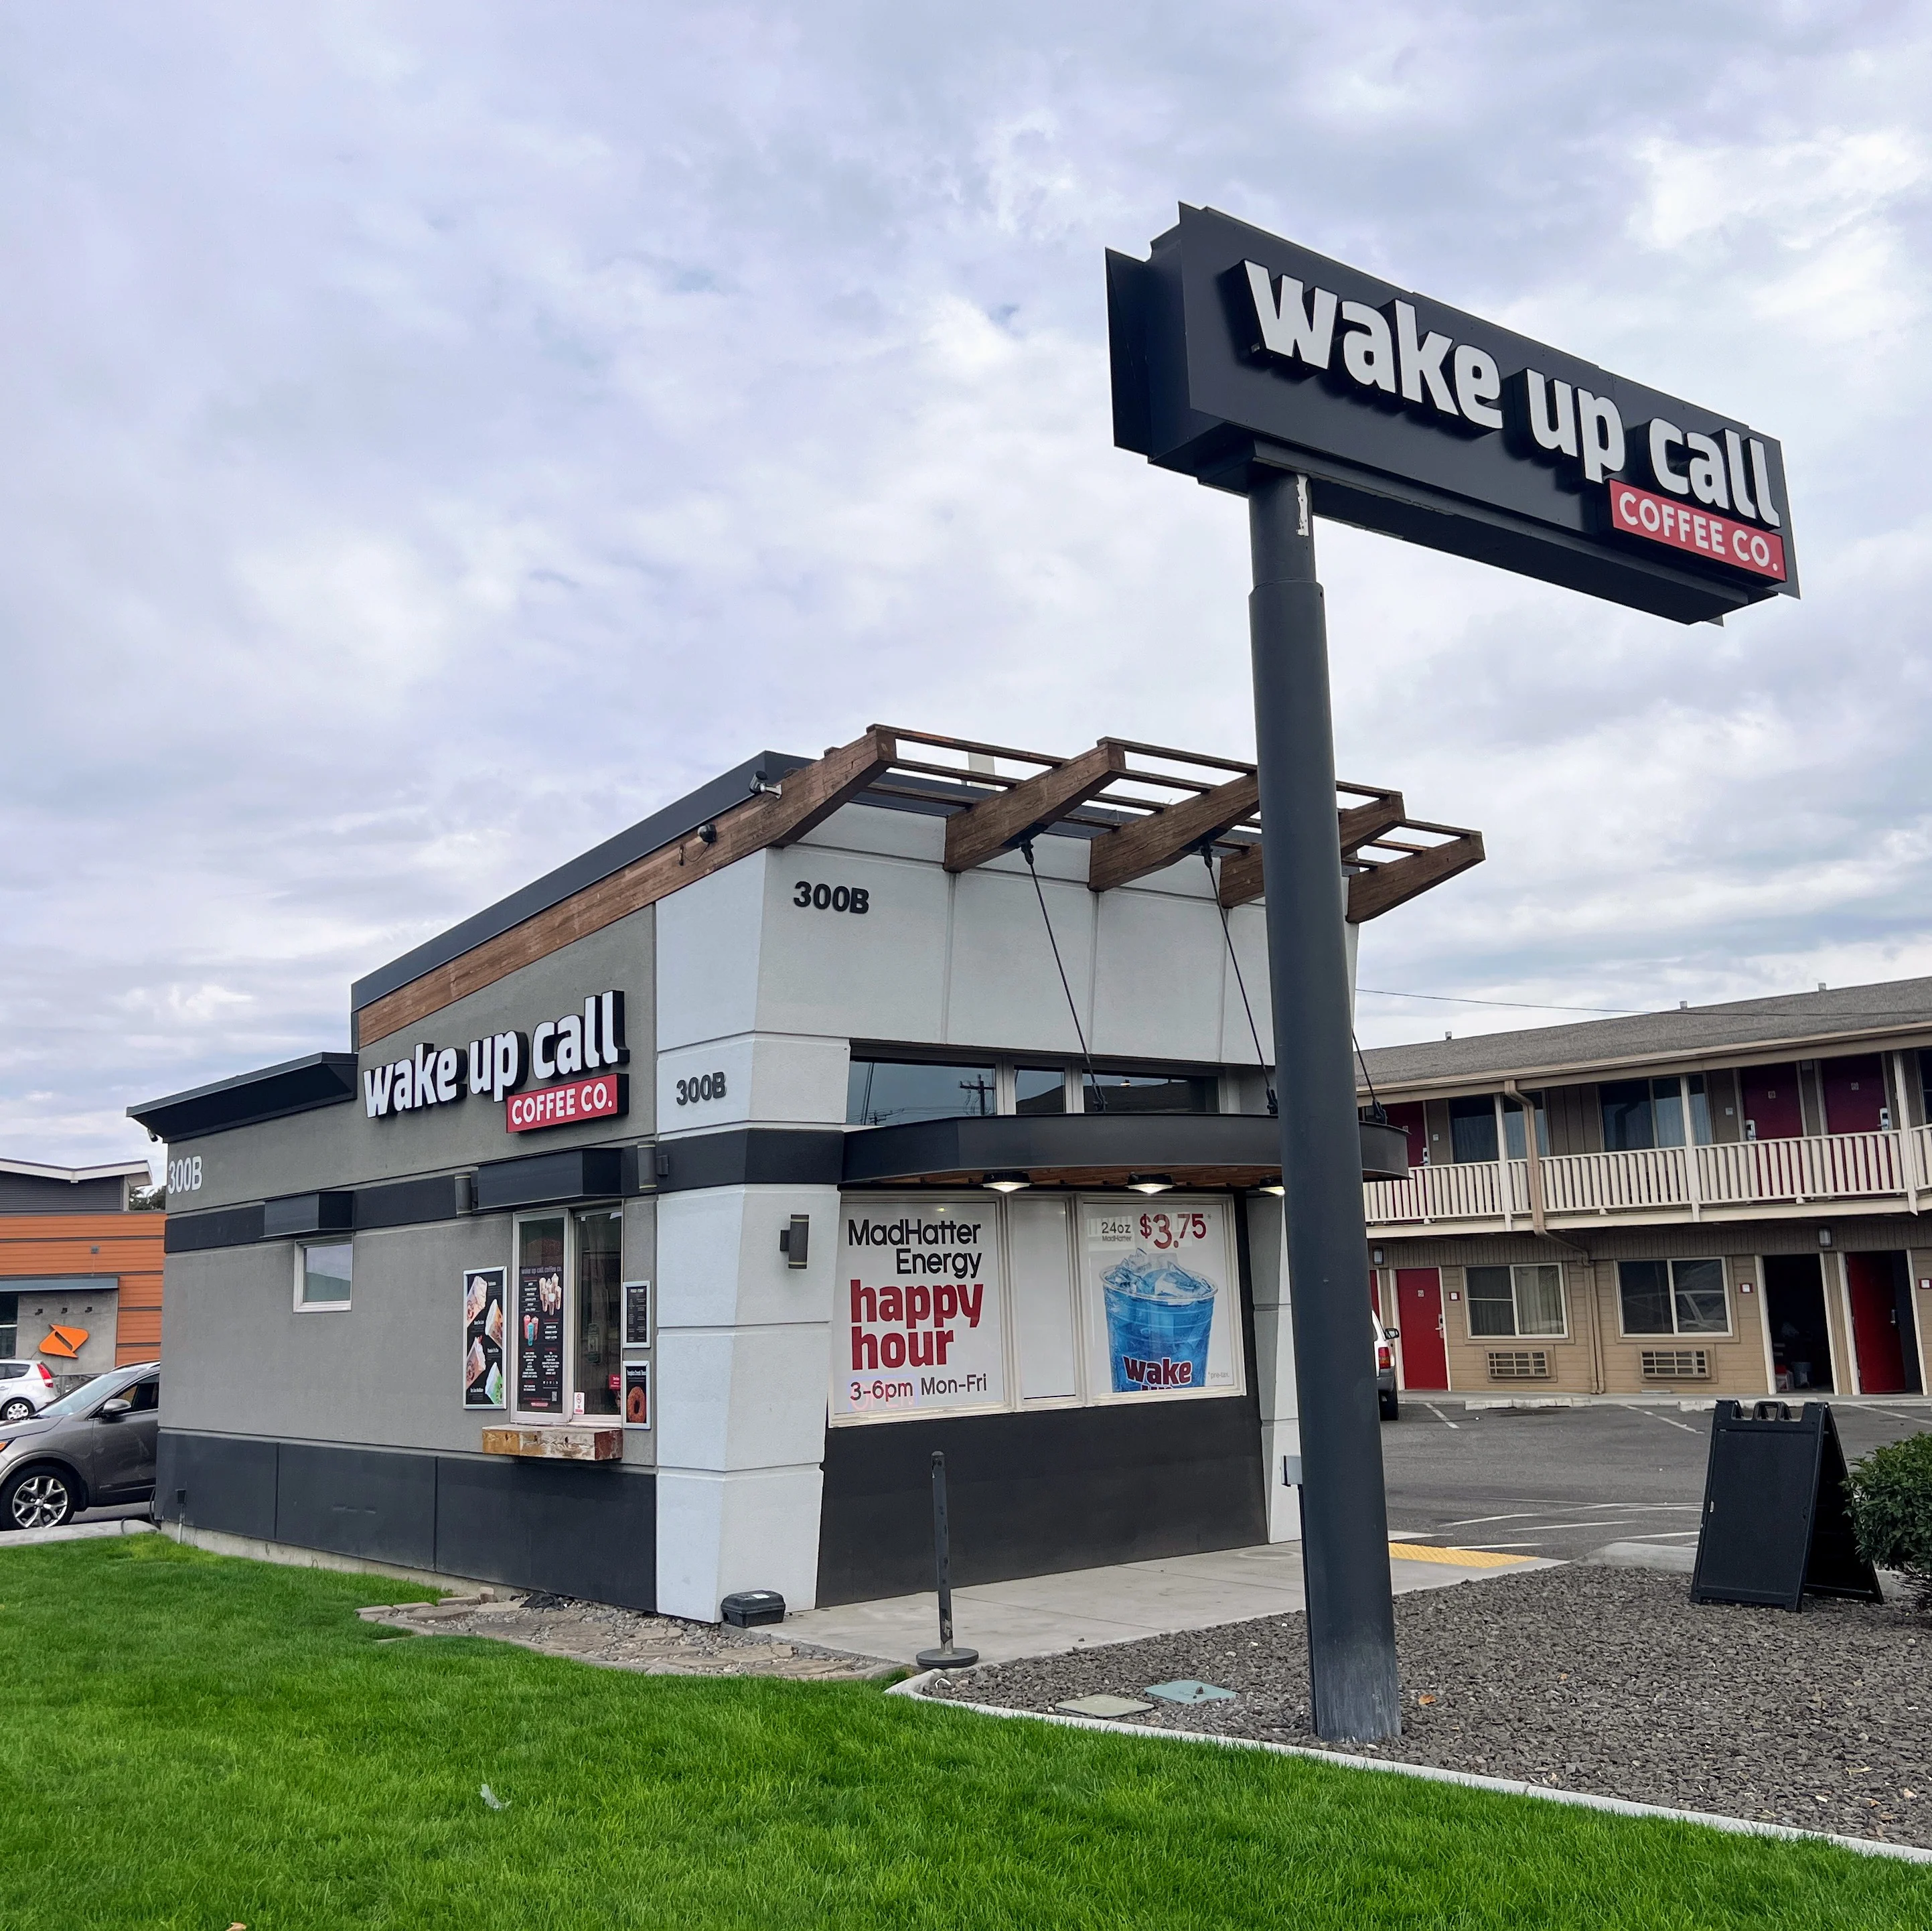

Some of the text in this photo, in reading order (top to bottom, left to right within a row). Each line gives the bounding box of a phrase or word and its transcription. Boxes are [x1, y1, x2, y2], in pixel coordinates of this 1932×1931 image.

[1244, 259, 1781, 528] wake up call
[1619, 491, 1779, 572] COFFEE CO.
[794, 881, 869, 914] 300B
[363, 990, 619, 1118] wake up call
[512, 1082, 613, 1125] COFFEE CO.
[676, 1072, 727, 1105] 300B
[168, 1155, 202, 1194] 300B
[848, 1218, 981, 1246] MadHatter
[1102, 1222, 1131, 1233] 24oz
[896, 1248, 982, 1279] Energy
[850, 1279, 984, 1329] happy
[851, 1326, 954, 1370] hour
[850, 1373, 987, 1402] 3-6pm Mon-Fri
[1122, 1356, 1191, 1385] wake
